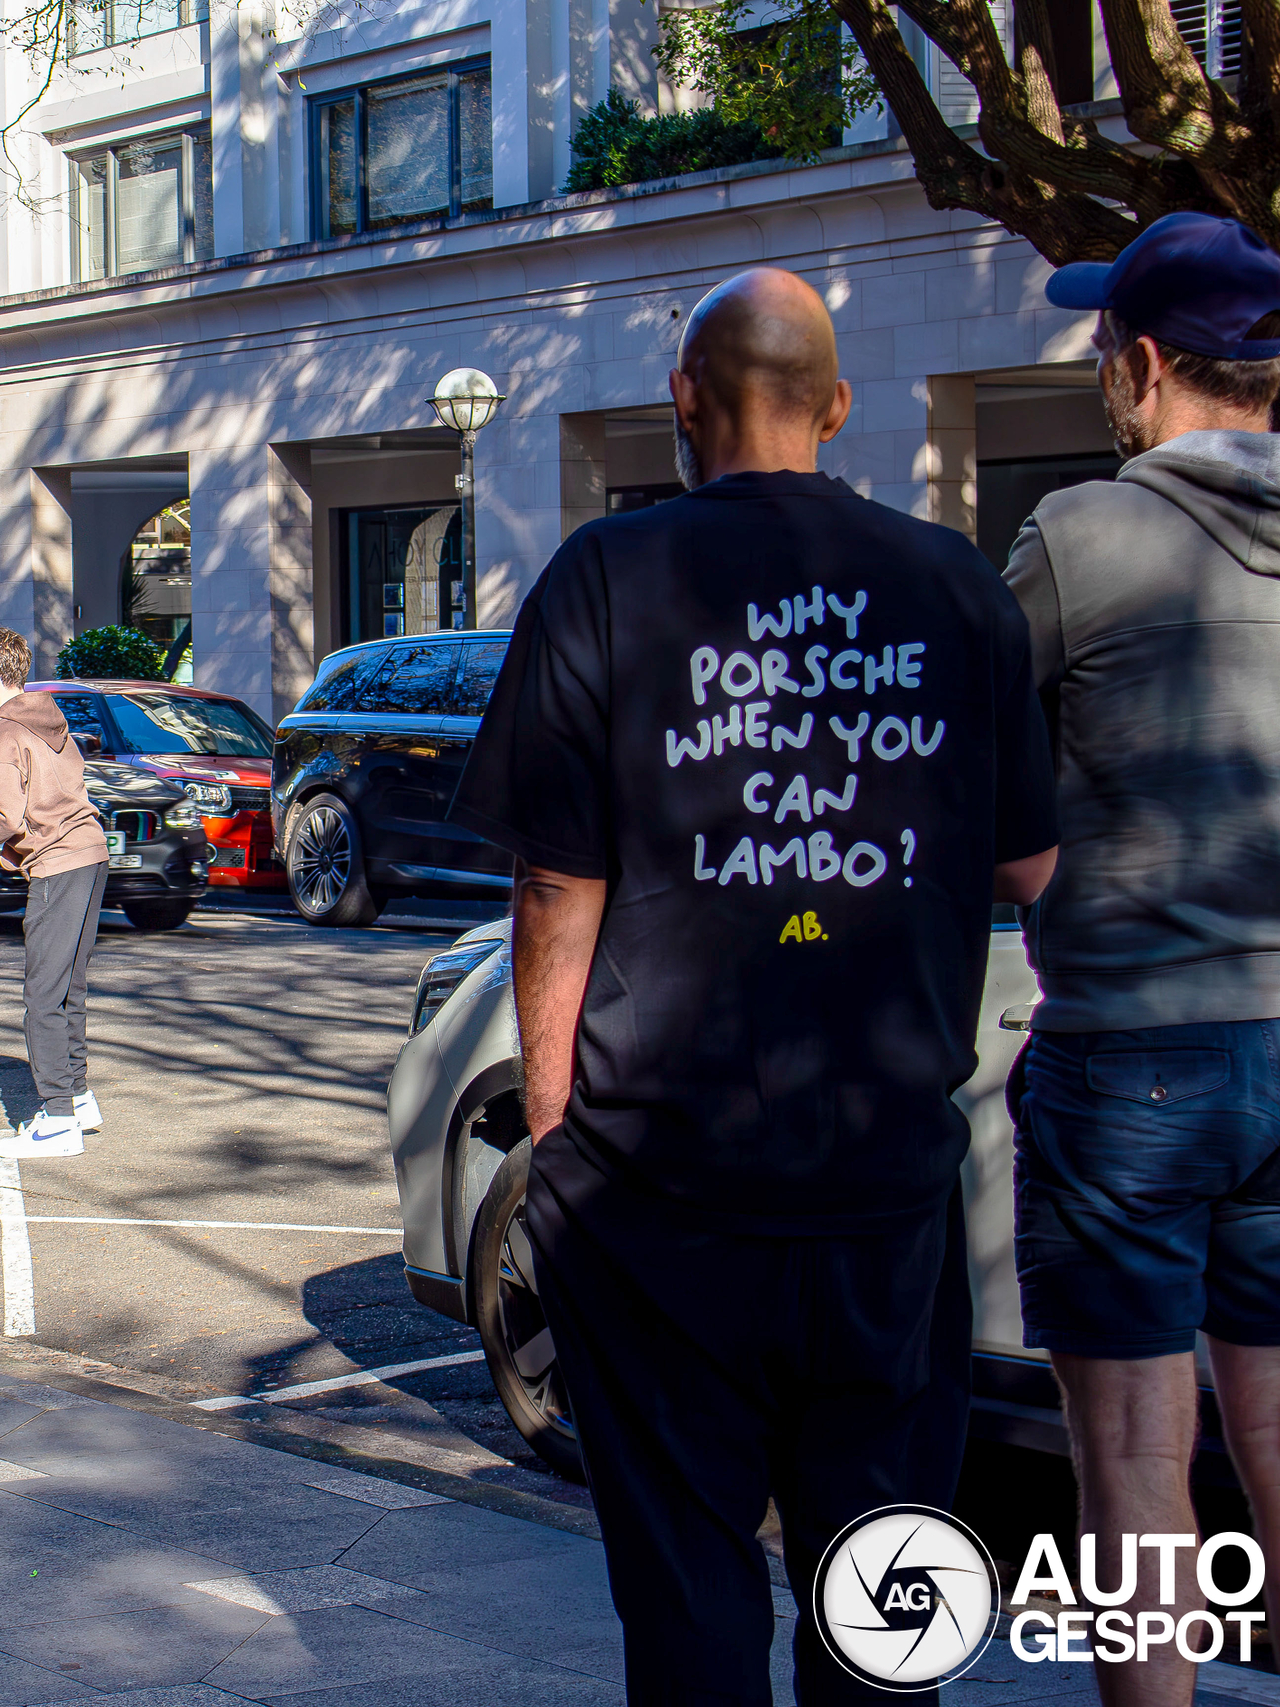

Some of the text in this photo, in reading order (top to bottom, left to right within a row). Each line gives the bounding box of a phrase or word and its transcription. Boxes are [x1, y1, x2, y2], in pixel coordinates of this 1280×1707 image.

[747, 585, 868, 640] WHY
[690, 643, 925, 705] PORSCHE
[666, 701, 945, 767] WHEN YOU
[743, 772, 858, 823] CAN
[779, 911, 828, 943] AB.
